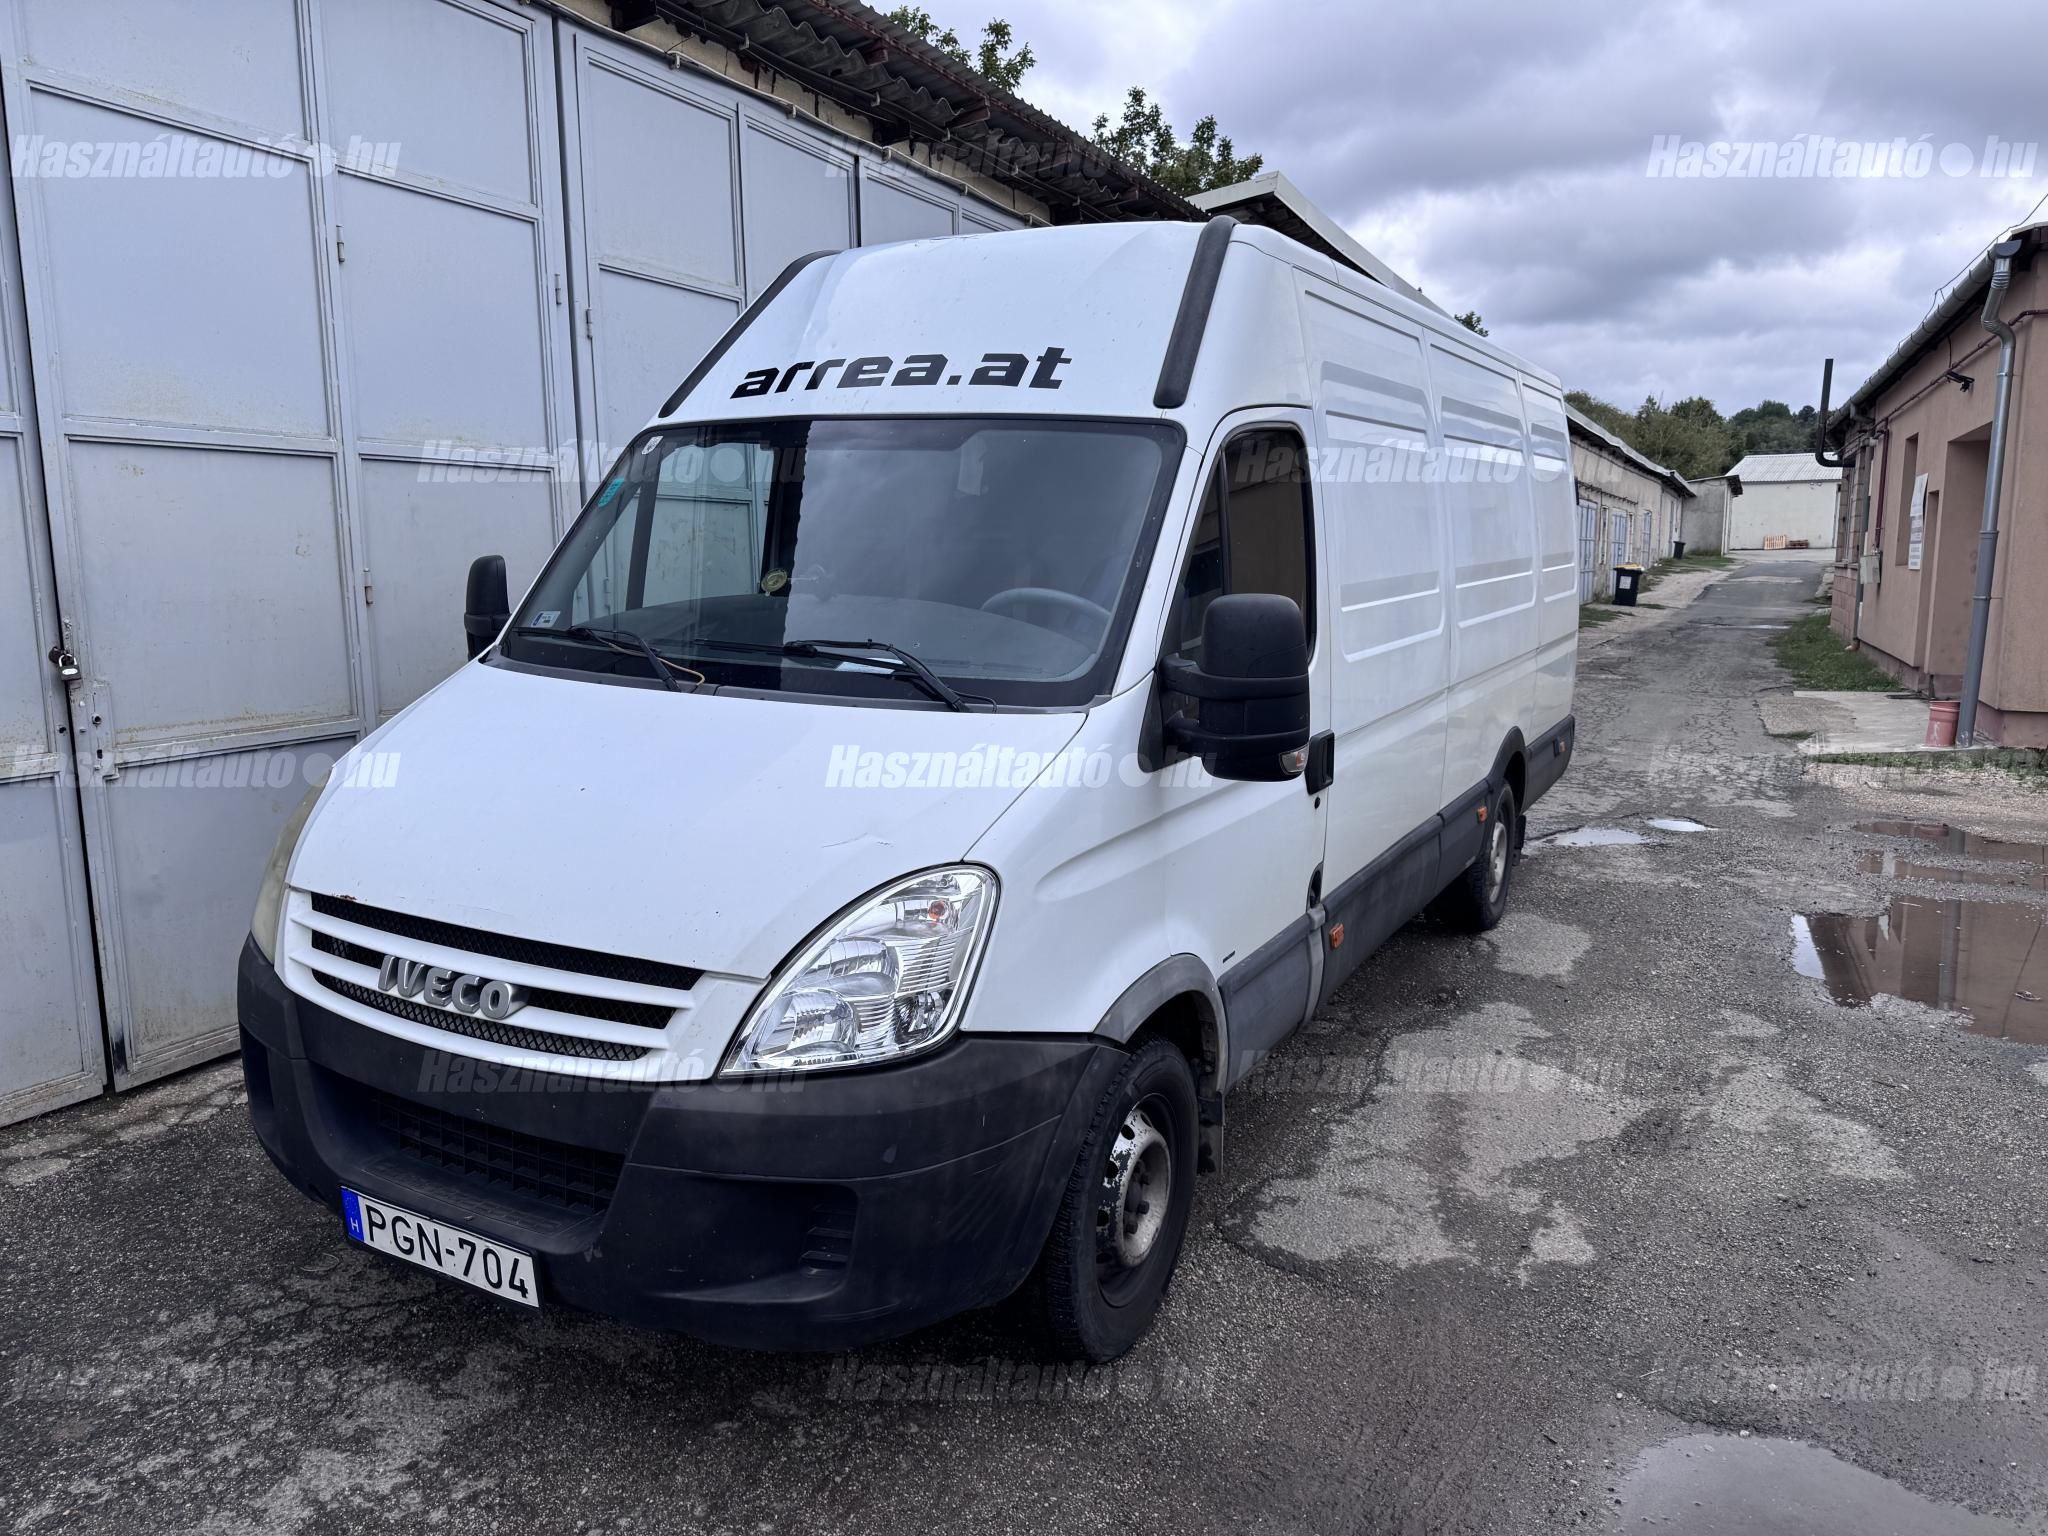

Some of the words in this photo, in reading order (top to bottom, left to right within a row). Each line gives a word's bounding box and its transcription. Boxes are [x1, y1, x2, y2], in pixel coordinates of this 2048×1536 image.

[730, 346, 1072, 399] arrea.at
[377, 954, 520, 1020] IVECO
[365, 1204, 529, 1299] PGN-704
